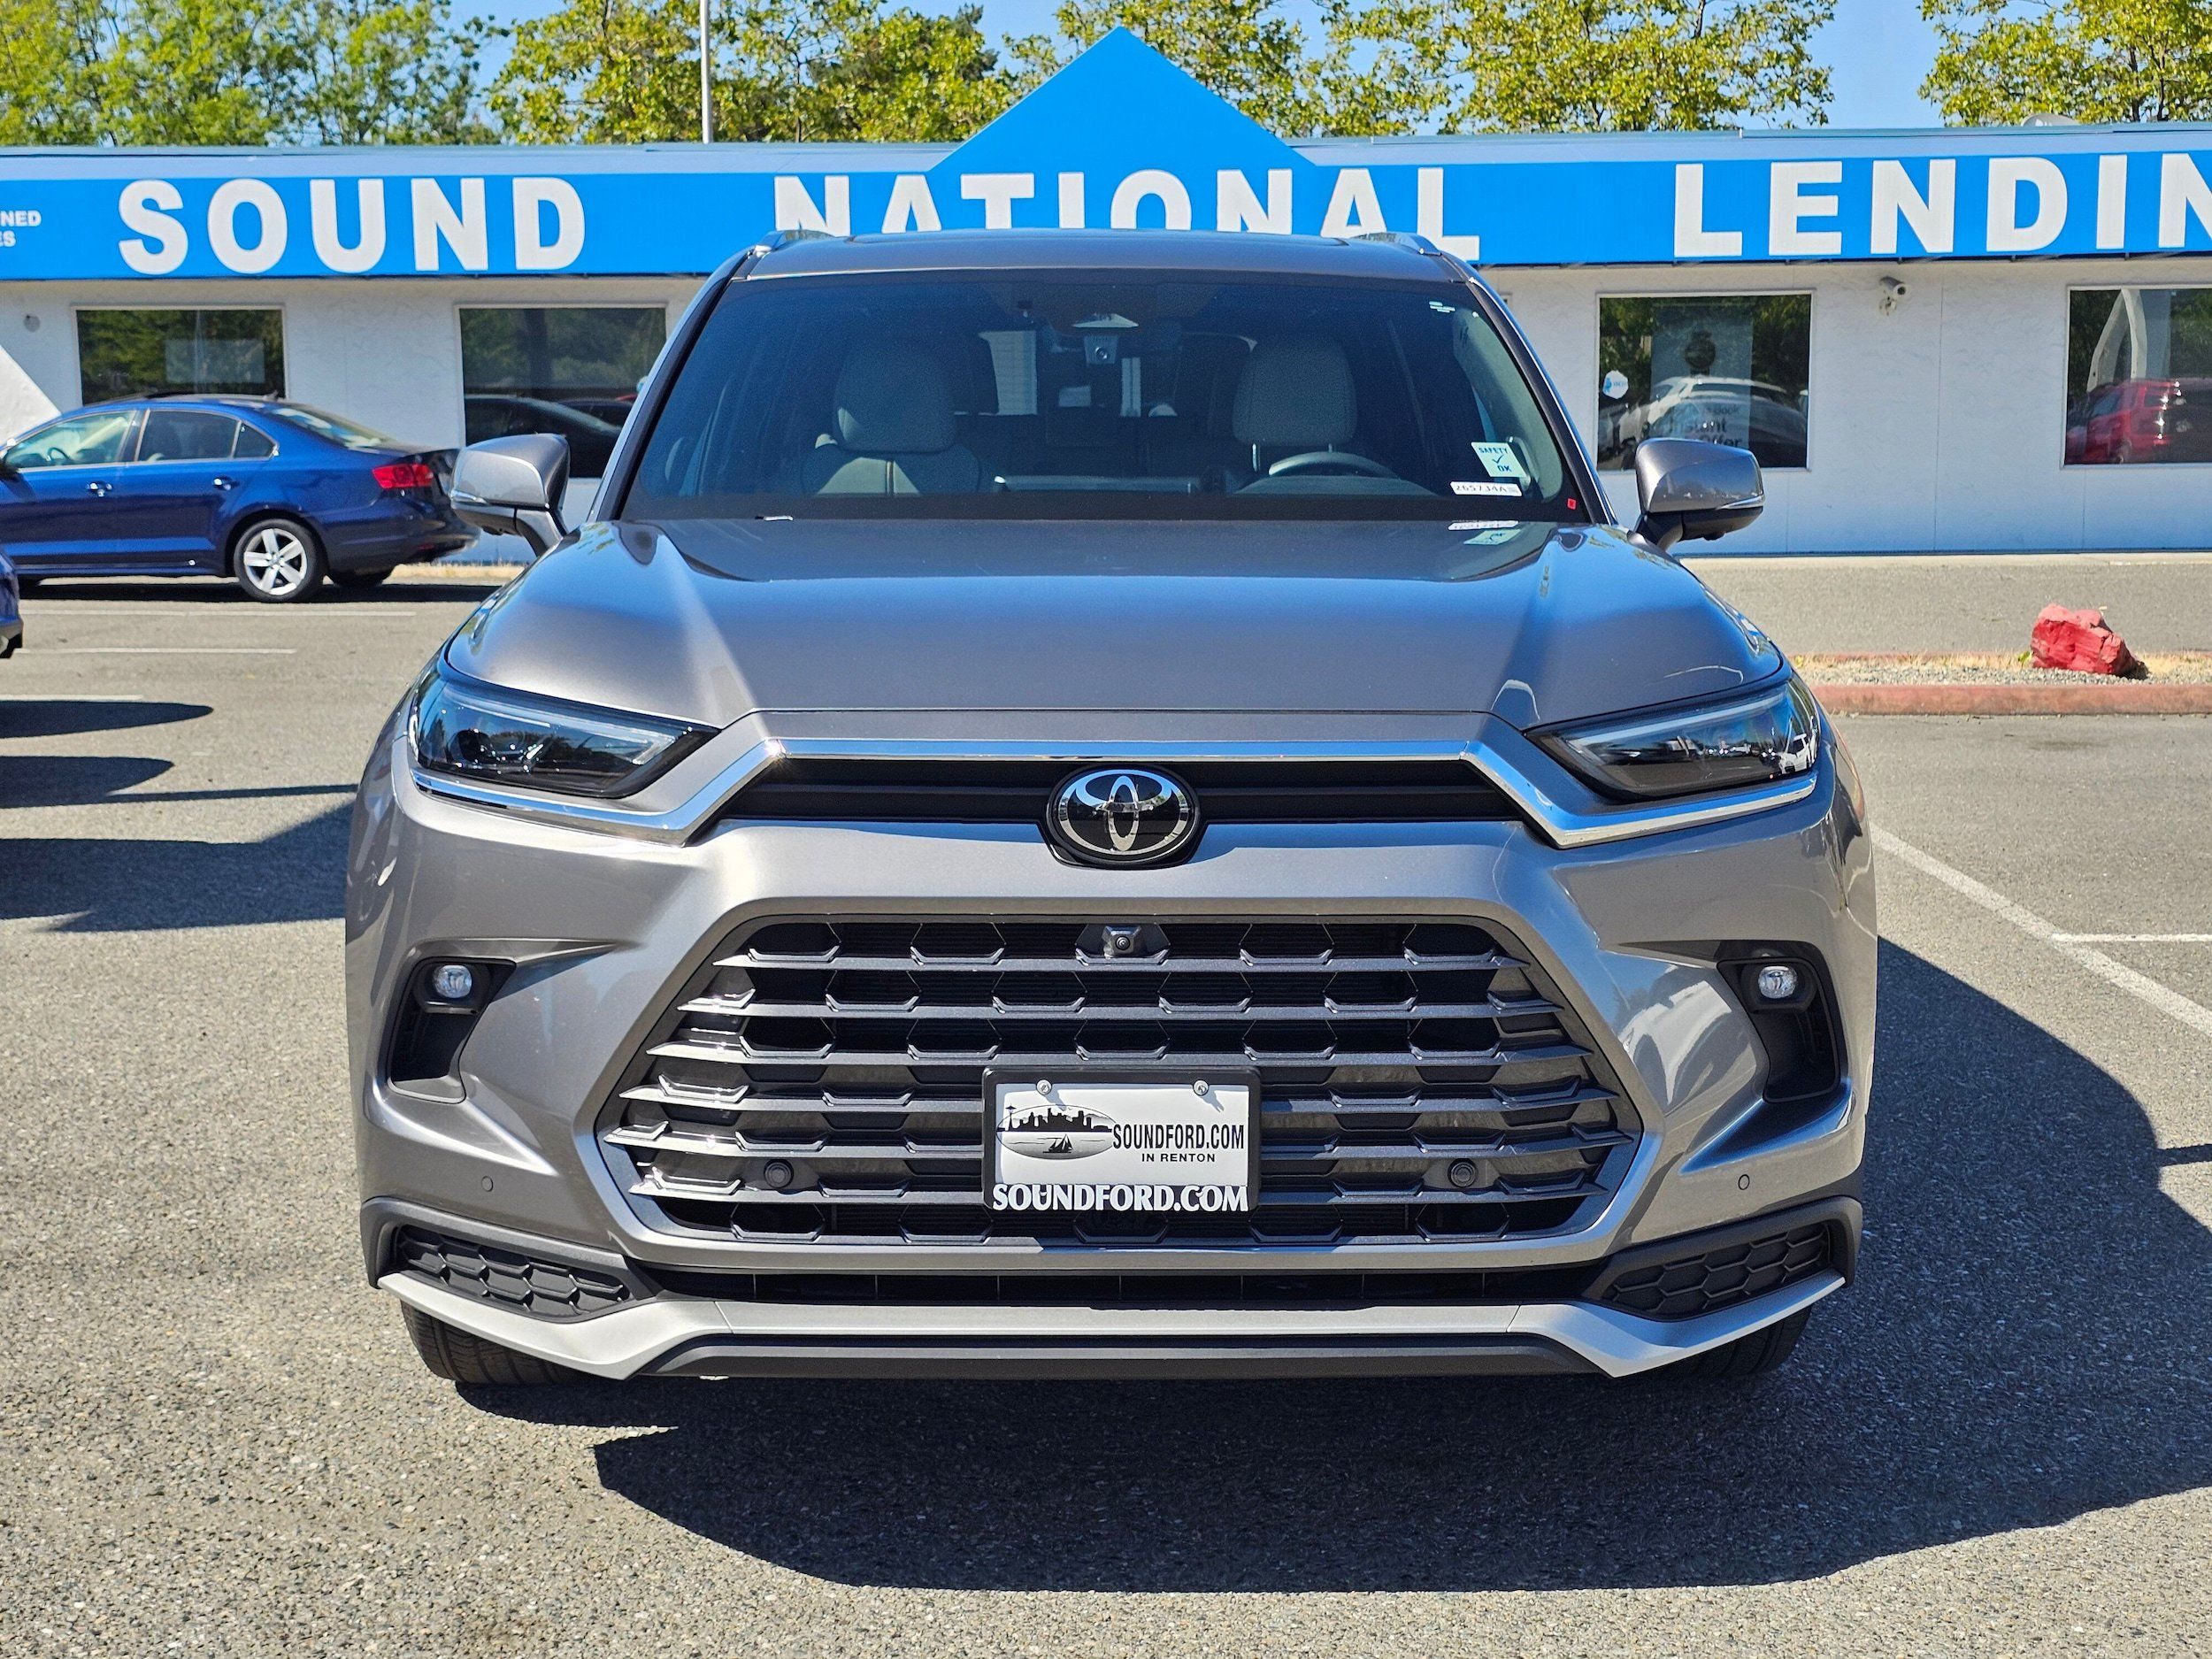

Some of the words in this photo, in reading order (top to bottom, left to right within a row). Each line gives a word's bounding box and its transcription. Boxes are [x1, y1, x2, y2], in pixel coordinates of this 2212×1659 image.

[119, 177, 586, 275] SOUND
[773, 166, 1479, 263] NATIONAL
[1673, 152, 2212, 257] LENDIN
[1112, 1124, 1244, 1149] SOUNDFORD.COM
[1141, 1153, 1155, 1163] IN
[1160, 1153, 1216, 1163] RENTON
[992, 1183, 1249, 1212] SOUNDFORD.COM
